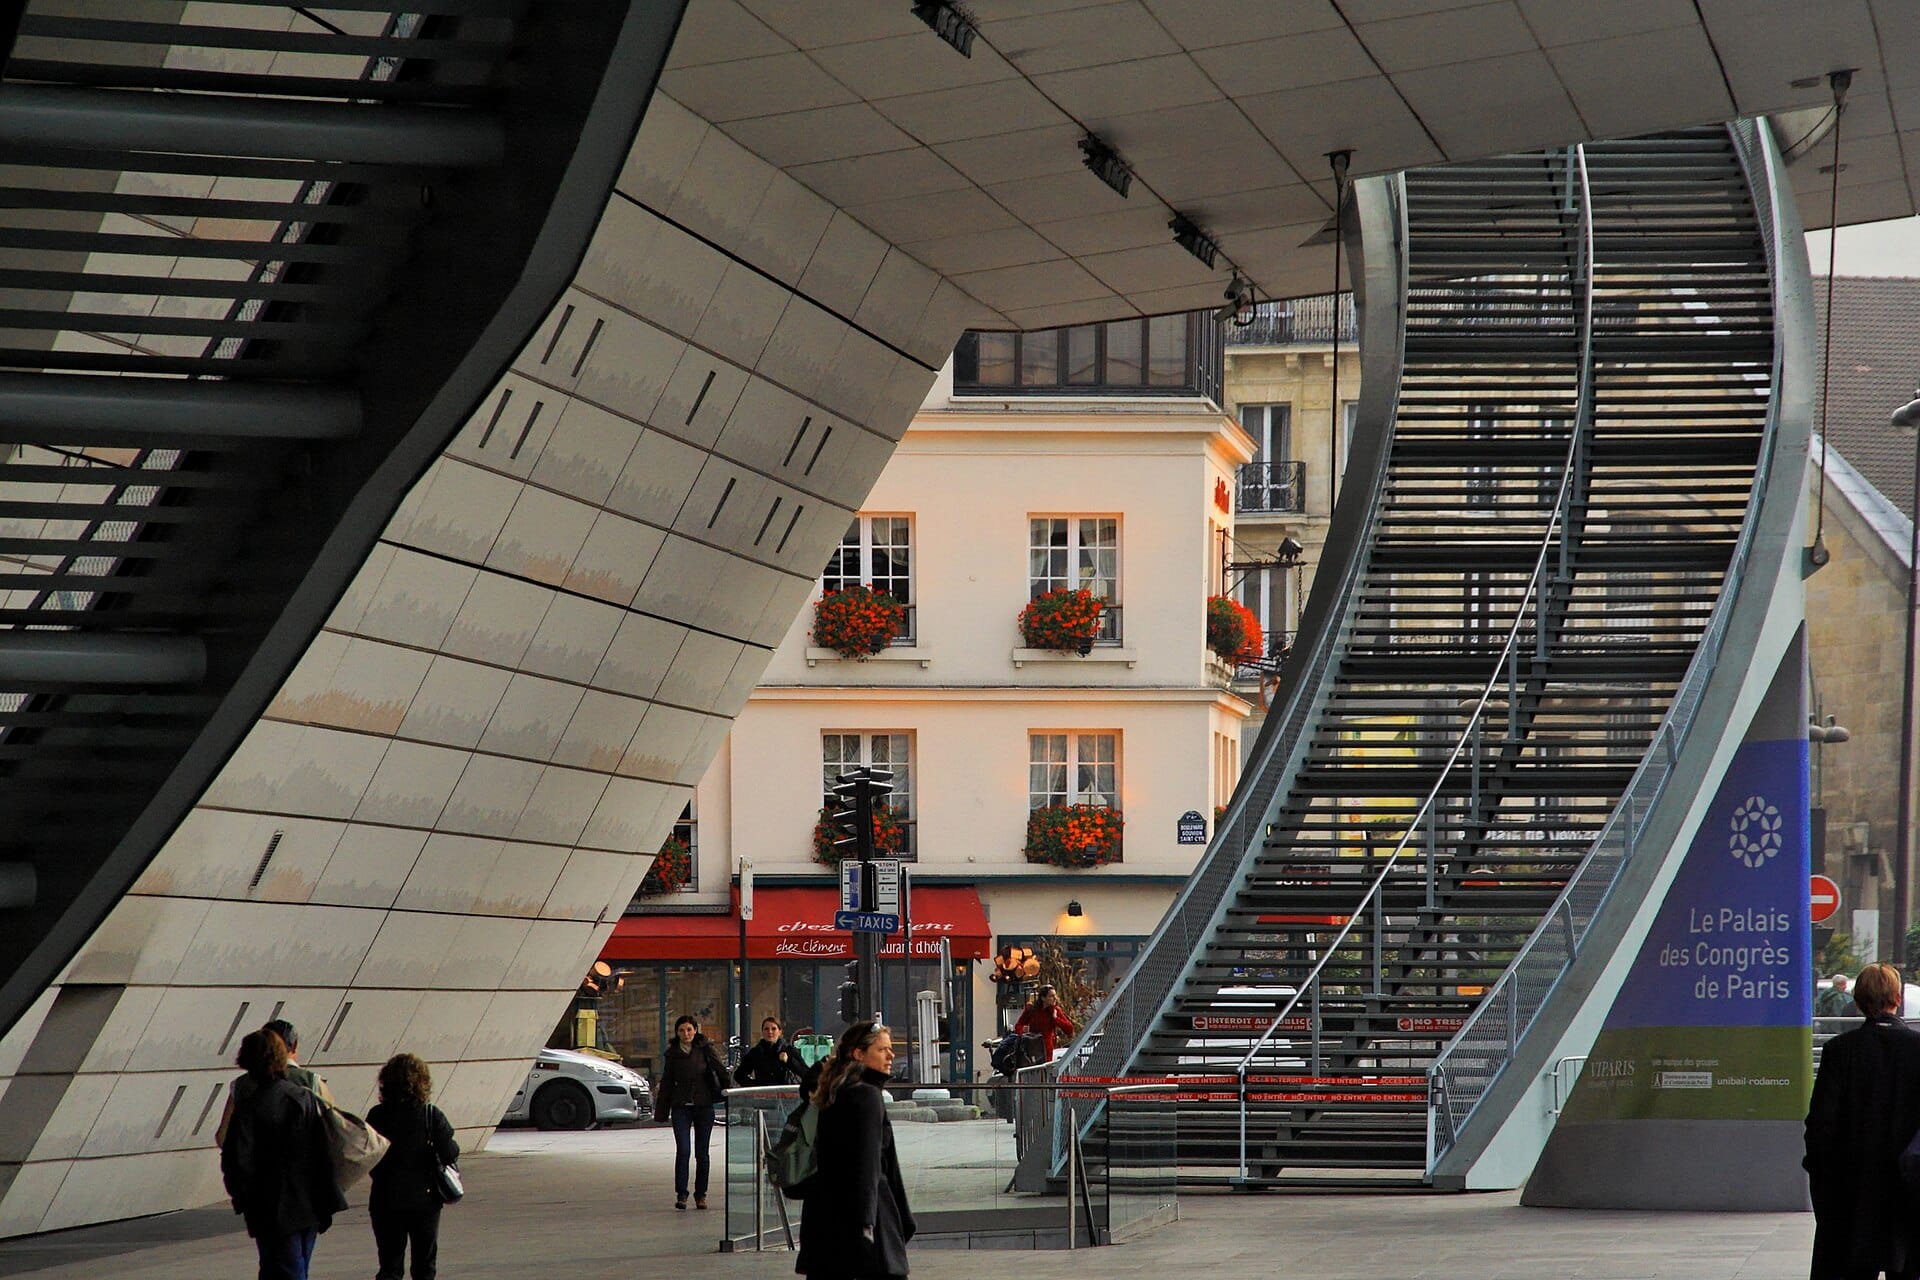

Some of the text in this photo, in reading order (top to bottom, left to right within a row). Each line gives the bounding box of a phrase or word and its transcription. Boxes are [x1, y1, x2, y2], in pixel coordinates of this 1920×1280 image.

[777, 920, 835, 932] chez
[858, 915, 893, 930] TAXIS
[1689, 907, 1790, 933] Le Palais
[776, 938, 800, 953] chez
[802, 939, 847, 953] Clément
[1659, 939, 1790, 972] des Congrès
[1694, 974, 1790, 999] de Paris
[1208, 1017, 1252, 1025] INTERDIT
[1590, 1059, 1636, 1078] VIPARIS
